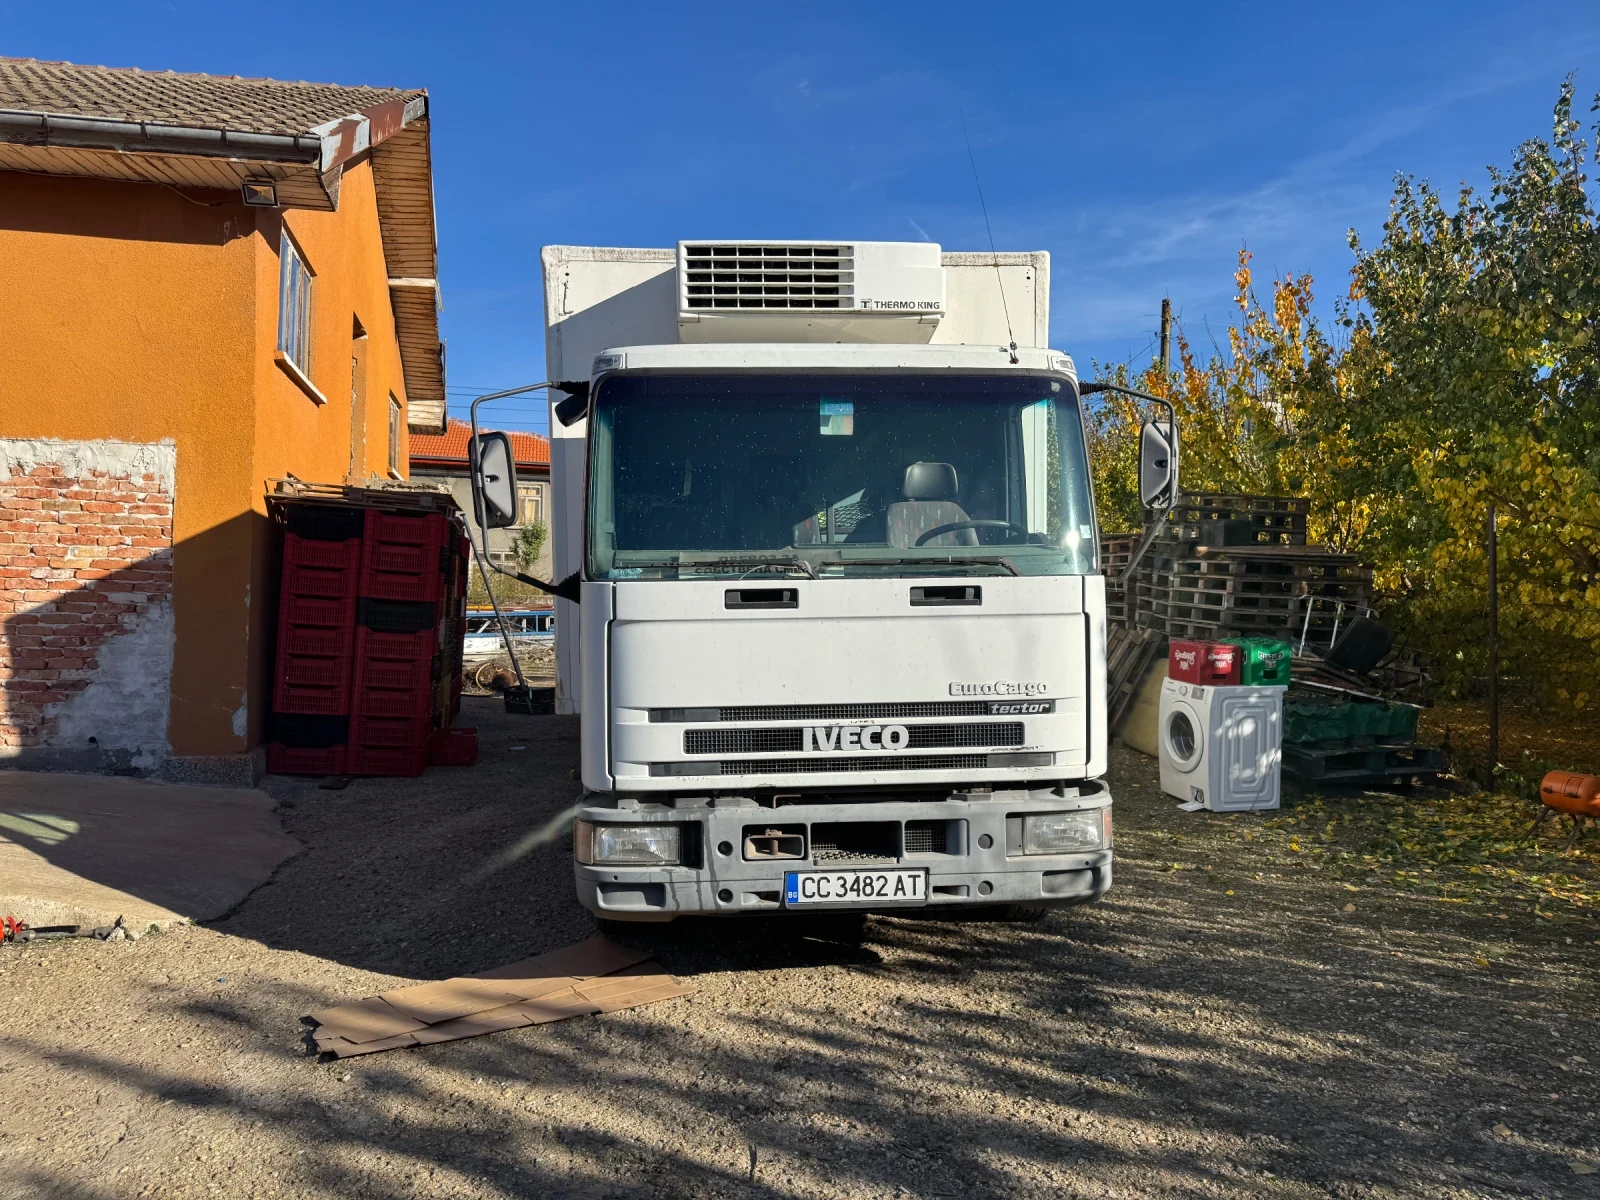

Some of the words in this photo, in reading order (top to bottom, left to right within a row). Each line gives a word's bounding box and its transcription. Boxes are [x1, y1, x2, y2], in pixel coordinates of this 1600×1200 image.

[874, 301, 916, 310] THERMO
[917, 301, 940, 310] KING
[948, 681, 1049, 697] EuroCargo
[990, 702, 1050, 715] tector
[802, 725, 909, 752] IVECO
[802, 876, 831, 899] CC
[835, 874, 888, 898] 3482
[893, 872, 922, 897] AT
[787, 891, 798, 899] BG
